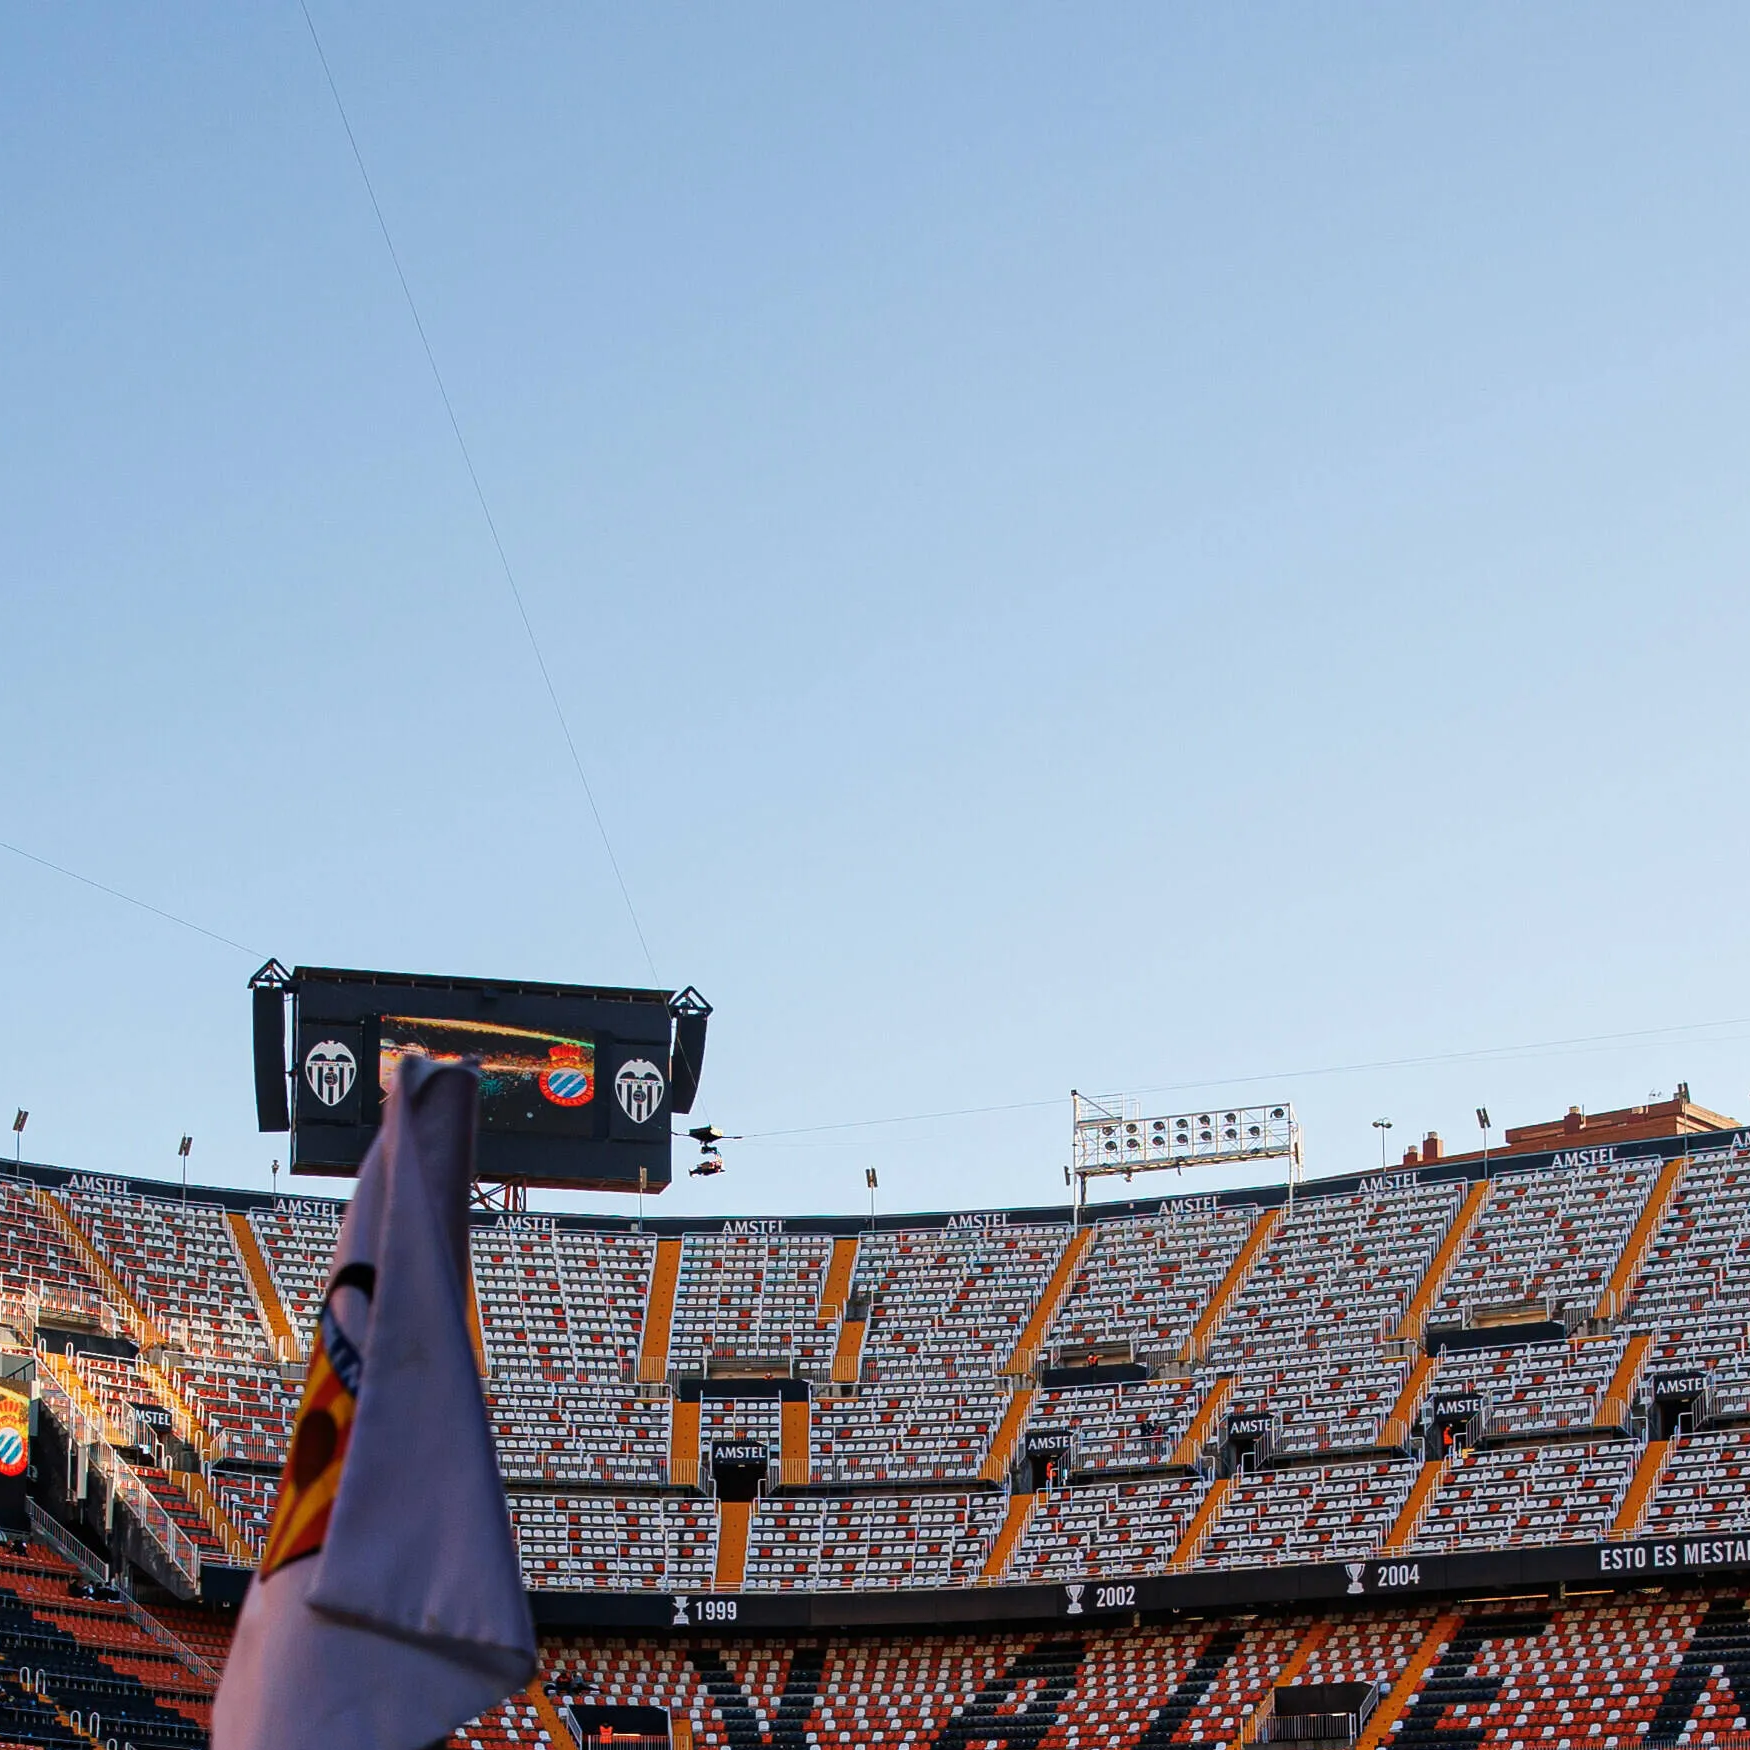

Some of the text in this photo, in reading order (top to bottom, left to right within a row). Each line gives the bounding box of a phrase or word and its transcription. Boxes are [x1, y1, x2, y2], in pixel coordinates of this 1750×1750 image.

[1551, 1148, 1615, 1170] AMSTEL
[69, 1174, 129, 1195] AMSTEL
[1357, 1174, 1419, 1195] AMSTEL
[275, 1199, 337, 1219] AMSTEL
[1158, 1196, 1218, 1216] AMSTEL
[494, 1217, 556, 1232] AMSTEL
[722, 1221, 784, 1234] AMSTEL
[947, 1213, 1009, 1229] AMSTEL
[1230, 1418, 1272, 1435] AMSTE
[715, 1447, 766, 1460] AMSTEL
[1600, 1546, 1648, 1571] ESTO
[1653, 1544, 1678, 1567] ES
[1377, 1564, 1420, 1587] 2004
[1096, 1585, 1136, 1609] 2002
[694, 1600, 738, 1621] 1999
